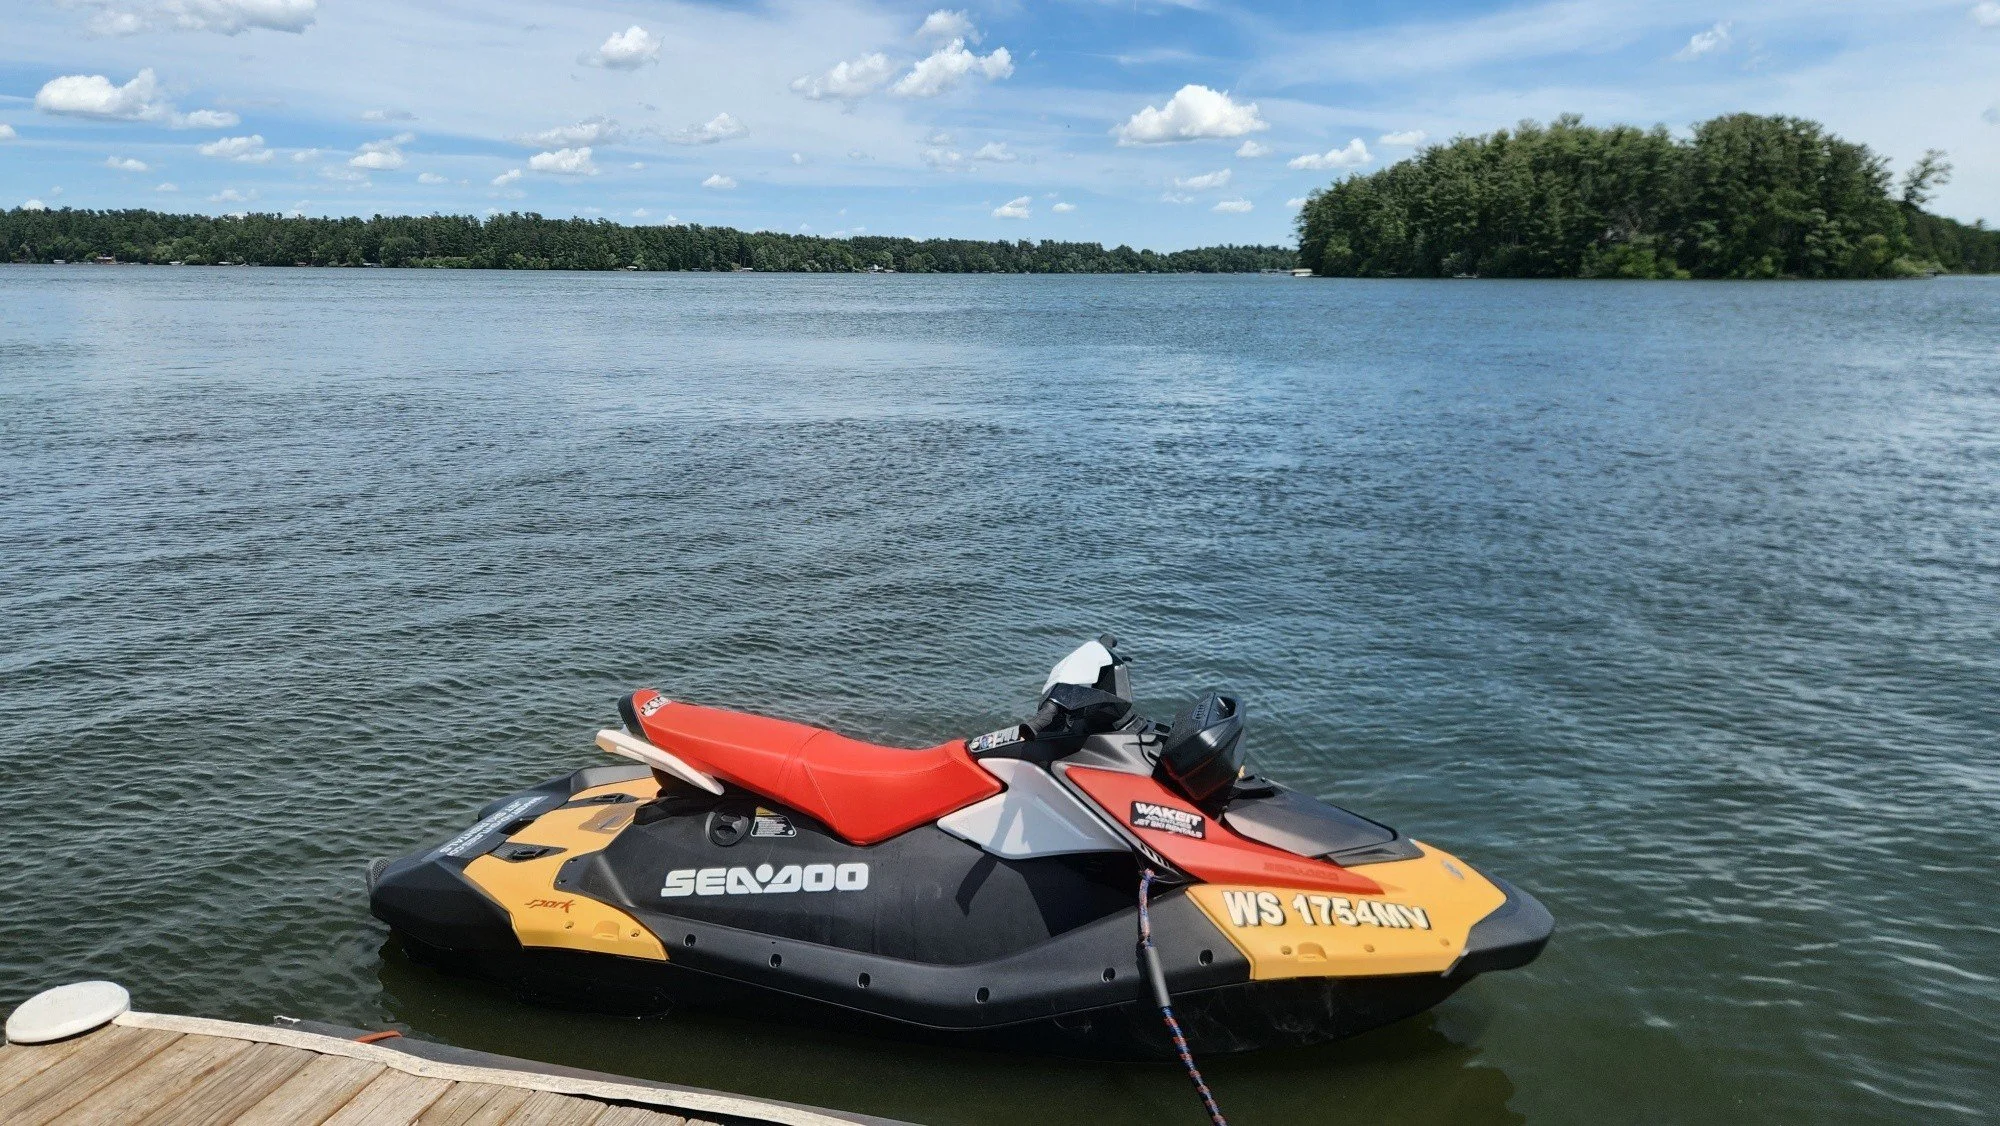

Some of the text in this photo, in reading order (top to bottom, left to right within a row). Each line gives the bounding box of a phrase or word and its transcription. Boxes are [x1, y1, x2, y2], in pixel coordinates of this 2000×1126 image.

[1135, 802, 1202, 826] WAKEIT
[1134, 818, 1203, 839] JET SKI RENTALS
[1222, 890, 1432, 930] WS 1754MV
